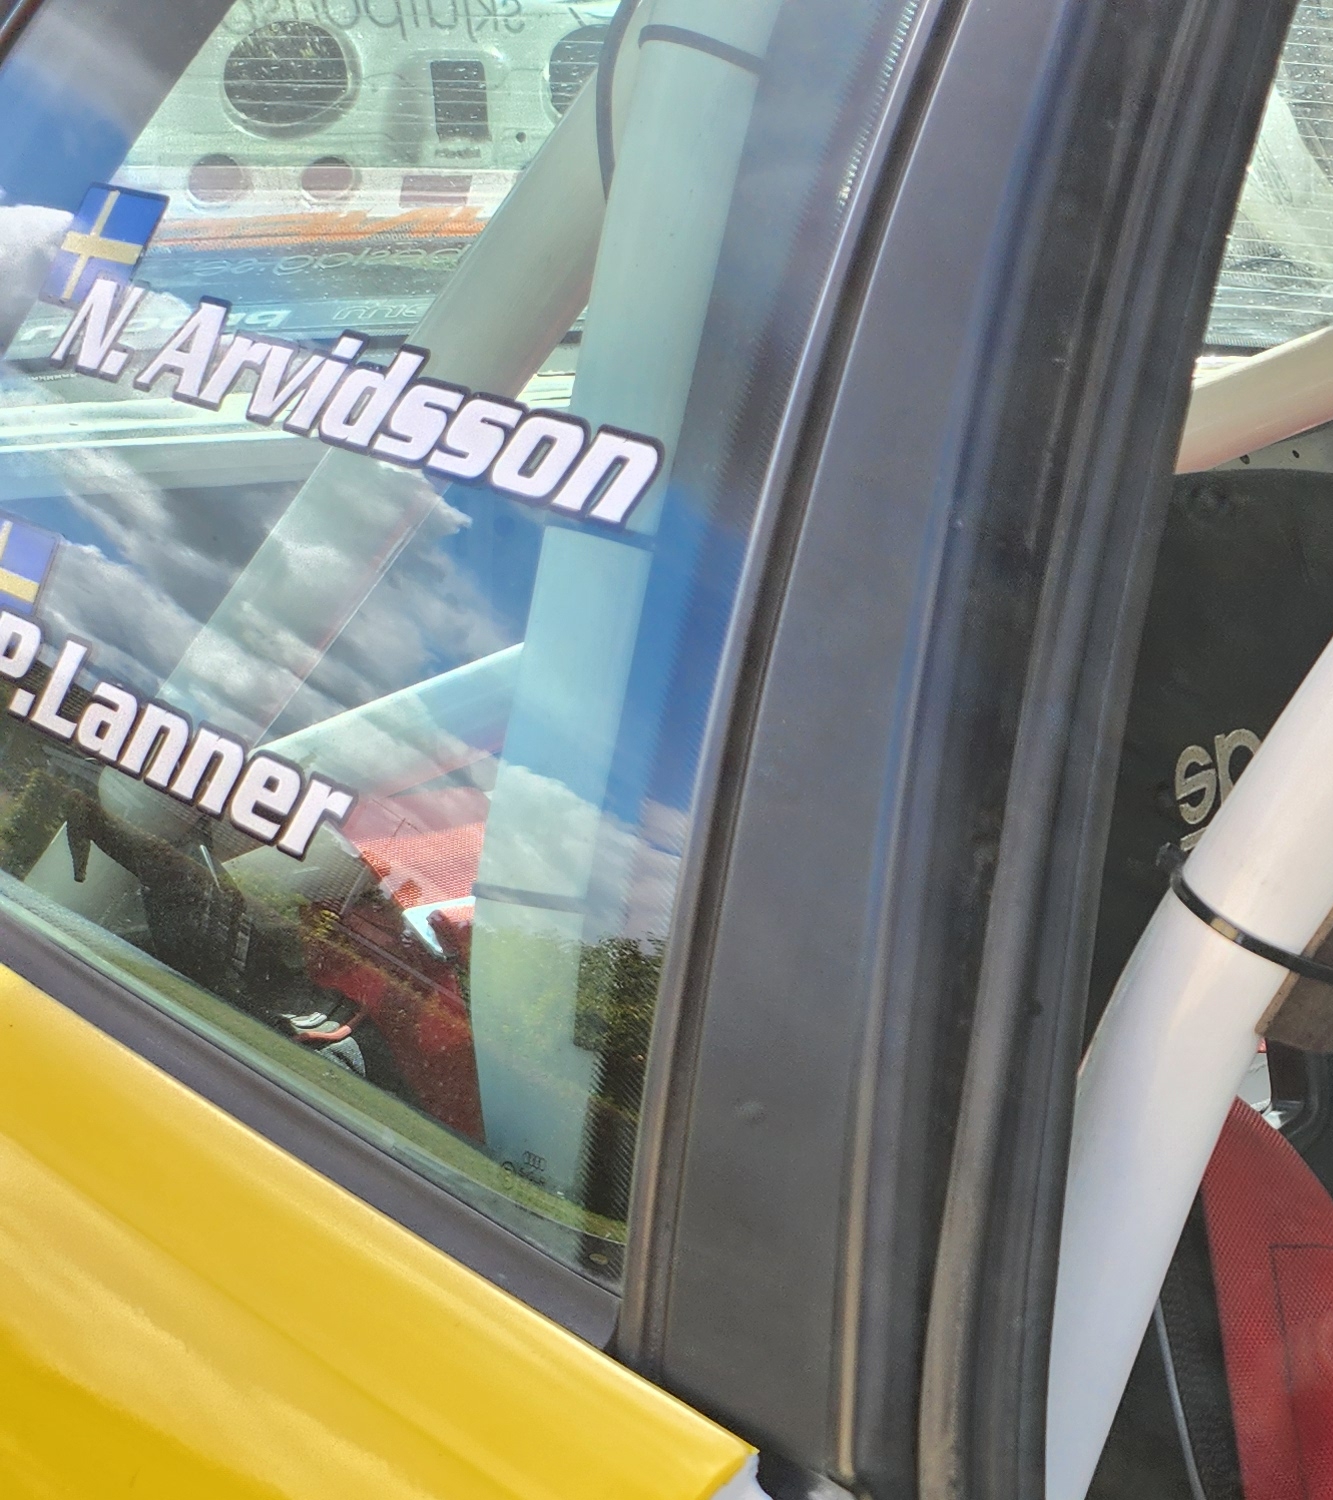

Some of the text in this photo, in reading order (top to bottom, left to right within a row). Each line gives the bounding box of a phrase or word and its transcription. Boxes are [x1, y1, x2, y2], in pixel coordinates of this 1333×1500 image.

[52, 278, 664, 527] N. Arvidsson
[0, 610, 358, 858] P.Lanner
